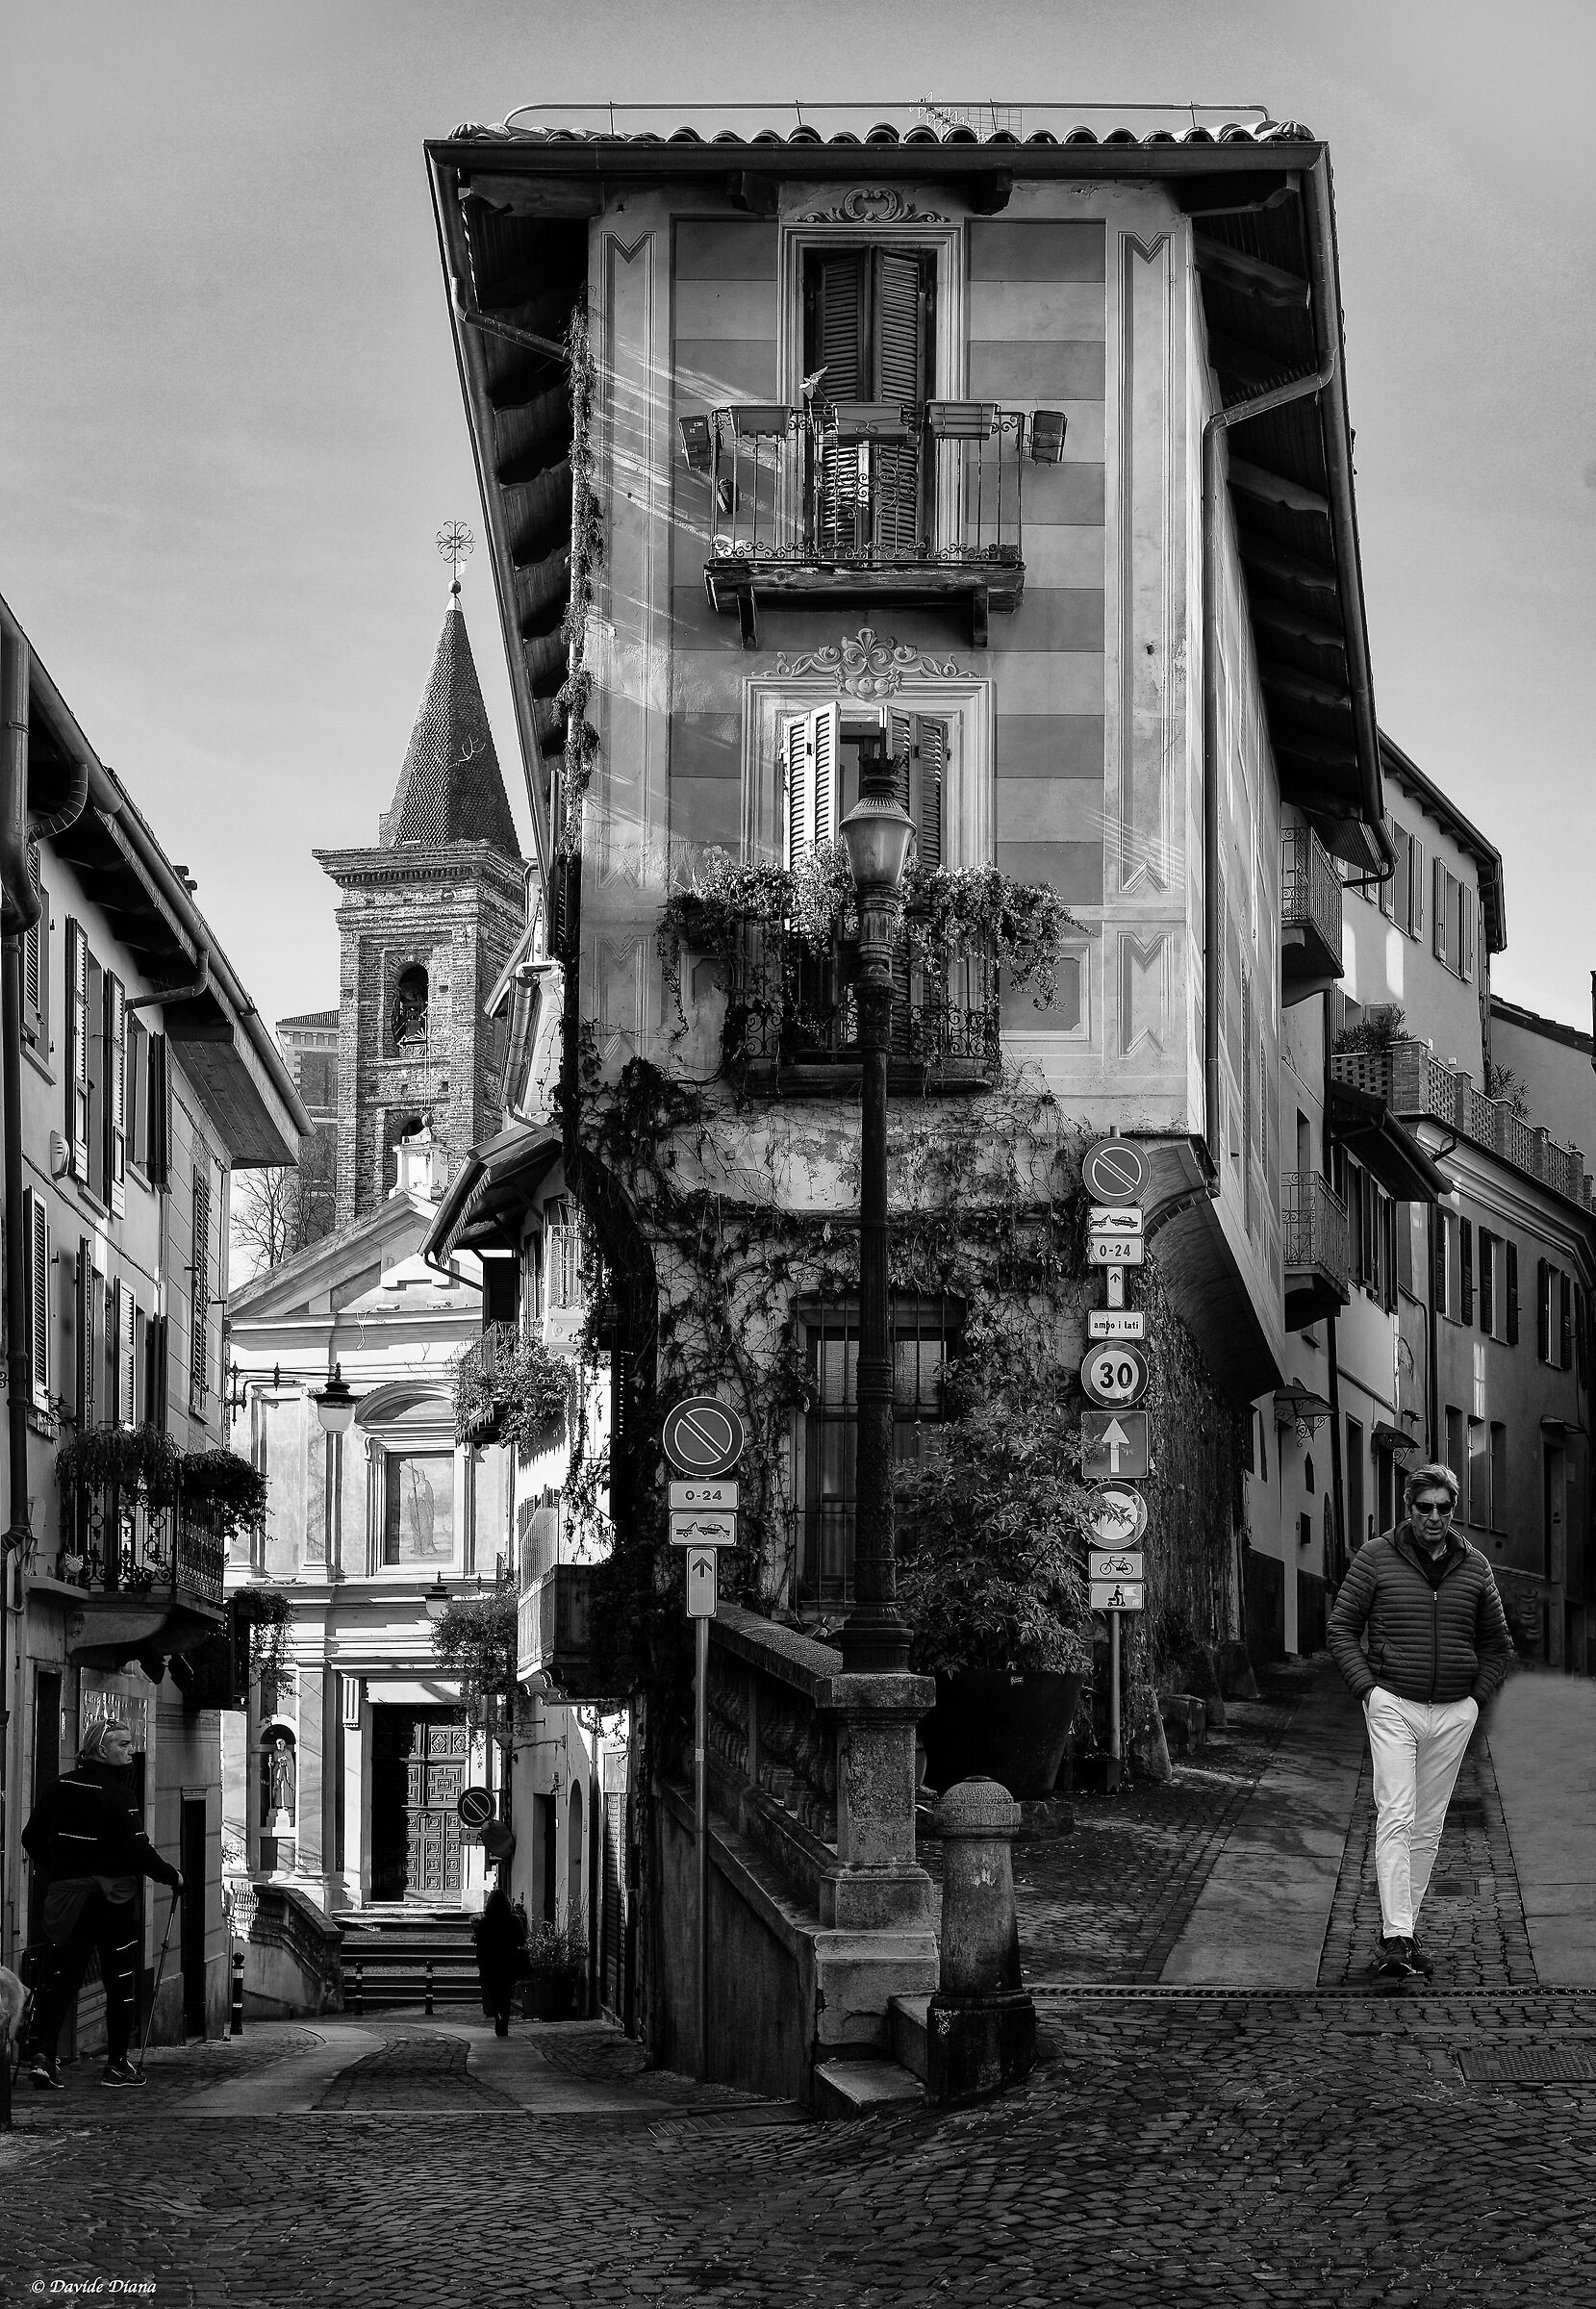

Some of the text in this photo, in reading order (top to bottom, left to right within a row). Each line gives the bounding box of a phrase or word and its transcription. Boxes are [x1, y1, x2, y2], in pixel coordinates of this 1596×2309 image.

[1100, 1244, 1131, 1257] 0-24
[1118, 1321, 1122, 1330] i
[1124, 1321, 1139, 1330] lati
[1099, 1361, 1133, 1389] 30
[685, 1489, 722, 1501] 0-24
